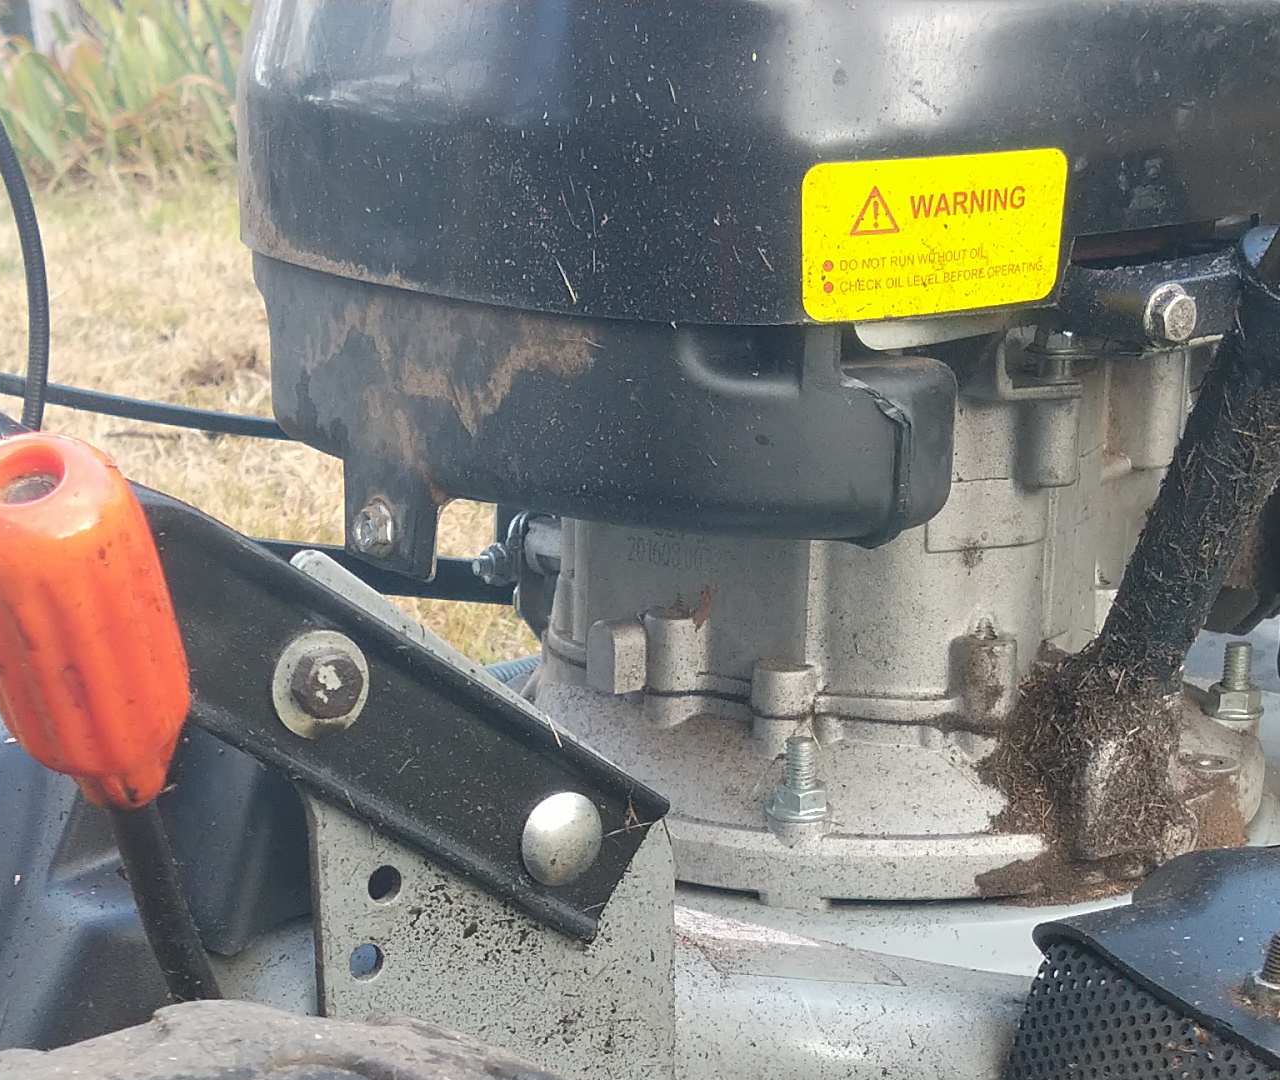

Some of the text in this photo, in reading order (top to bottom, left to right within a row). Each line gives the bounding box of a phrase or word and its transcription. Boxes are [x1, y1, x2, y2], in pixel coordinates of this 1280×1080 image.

[910, 185, 1026, 219] WARNING
[839, 259, 858, 271] DO
[861, 256, 887, 269] NOT
[890, 254, 915, 267] RUN
[917, 249, 968, 265] WITHOUT
[839, 260, 1043, 293] CHECK OIL LEVEL BEFORE OPERATING
